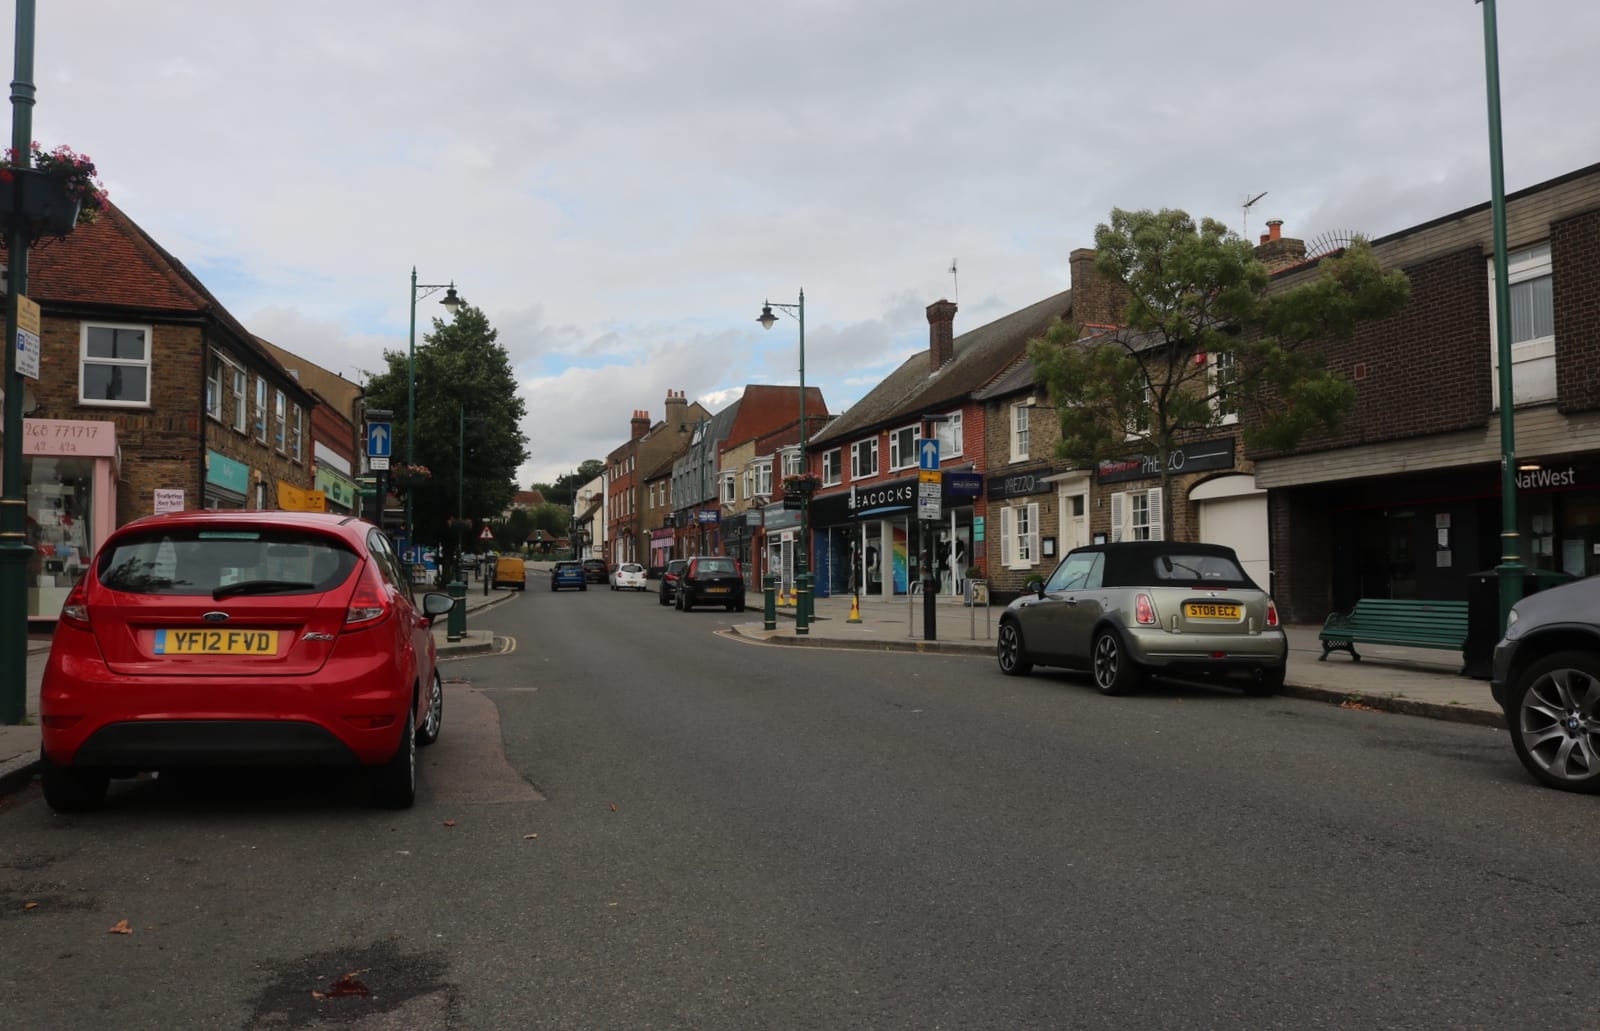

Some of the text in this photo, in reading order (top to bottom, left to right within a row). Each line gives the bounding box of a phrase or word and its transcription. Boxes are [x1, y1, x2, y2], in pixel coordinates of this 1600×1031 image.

[55, 425, 98, 439] 771717
[1190, 605, 1237, 617] ST08 ECZ
[175, 632, 270, 651] YF12 FVD
